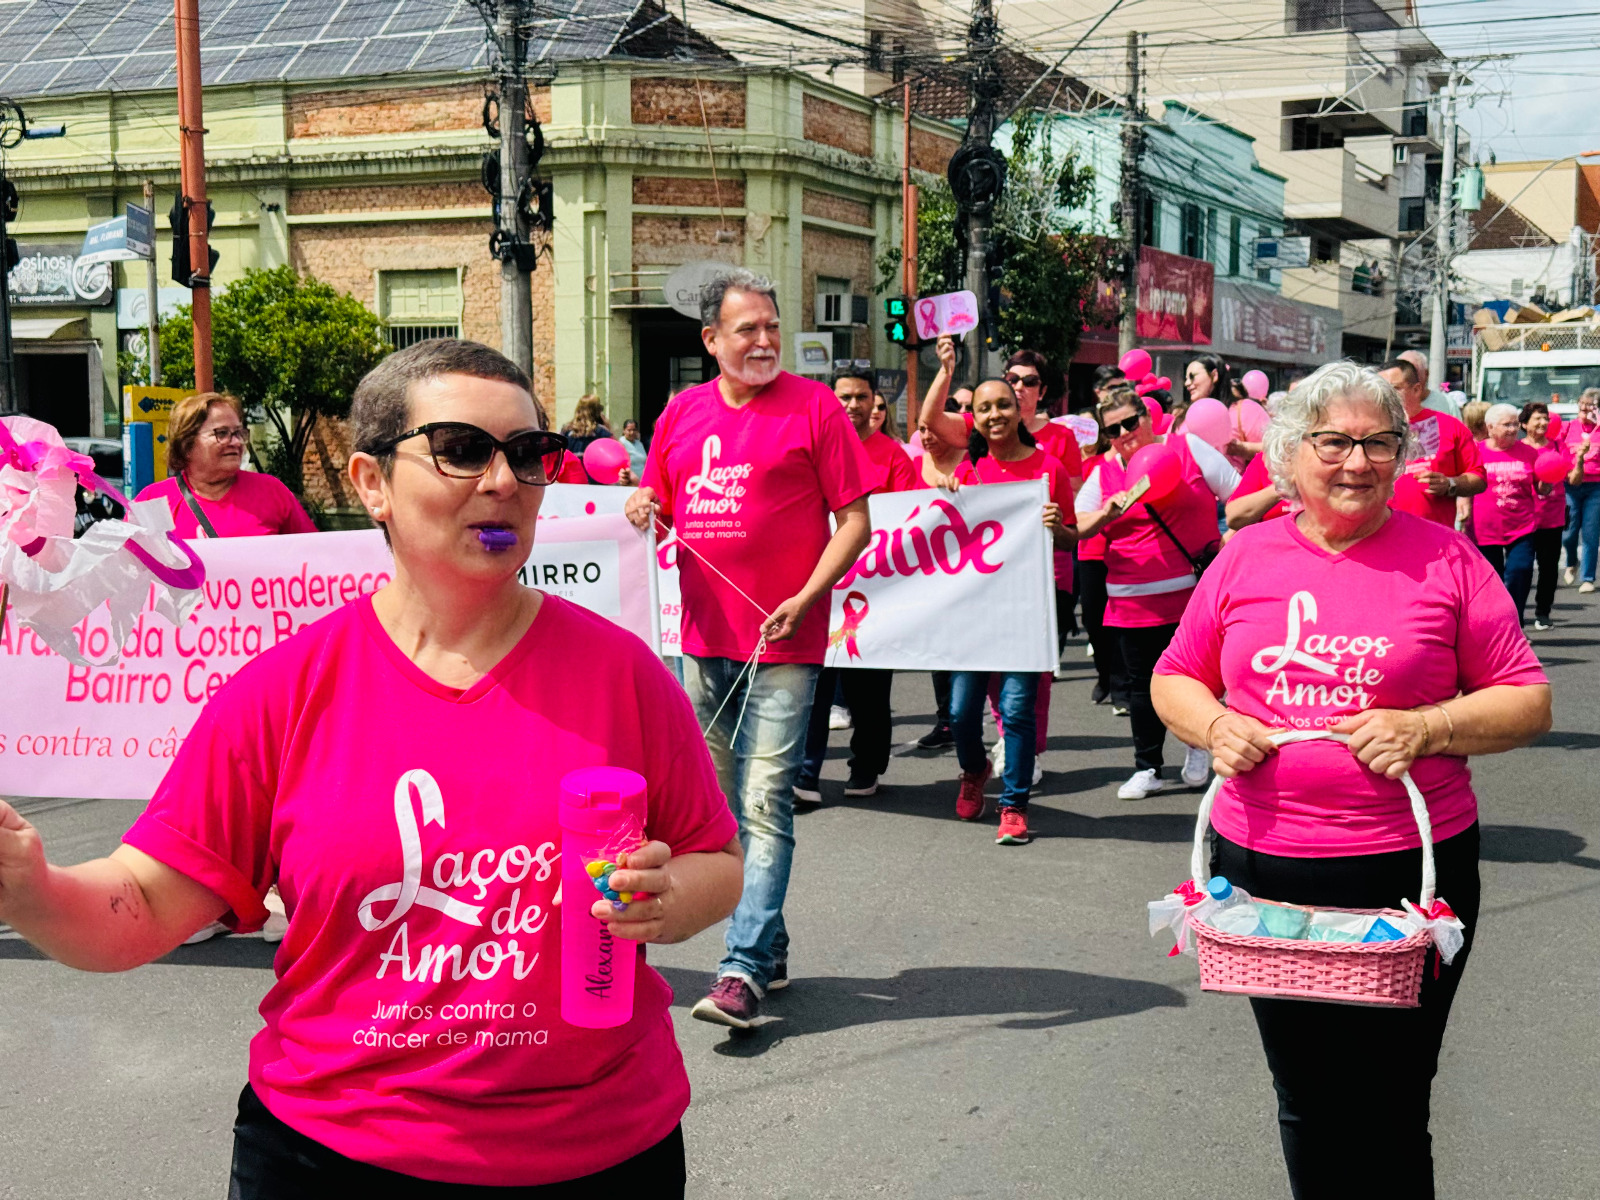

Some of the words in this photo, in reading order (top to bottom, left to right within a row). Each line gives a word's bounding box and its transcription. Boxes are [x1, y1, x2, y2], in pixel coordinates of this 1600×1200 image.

[685, 434, 754, 495] Laços
[685, 492, 742, 514] Amor
[725, 481, 746, 498] de
[704, 530, 715, 539] de
[705, 519, 732, 528] contra
[832, 498, 1004, 590] aúde
[0, 612, 109, 656] Arado
[122, 613, 163, 658] da
[175, 612, 262, 658] Costa
[1251, 591, 1395, 674] Laços
[66, 662, 171, 704] Bairro
[1265, 671, 1377, 709] Amor
[1344, 658, 1384, 685] de
[16, 726, 112, 757] contra
[123, 737, 139, 757] o
[148, 726, 185, 757] câ
[357, 768, 562, 932] Laços
[491, 888, 548, 935] de
[376, 921, 540, 983] Amor
[371, 999, 433, 1020] Juntos
[440, 999, 515, 1020] contra
[522, 1002, 537, 1018] o
[352, 1026, 430, 1049] câncer
[436, 1028, 468, 1046] de
[474, 1028, 549, 1047] mama
